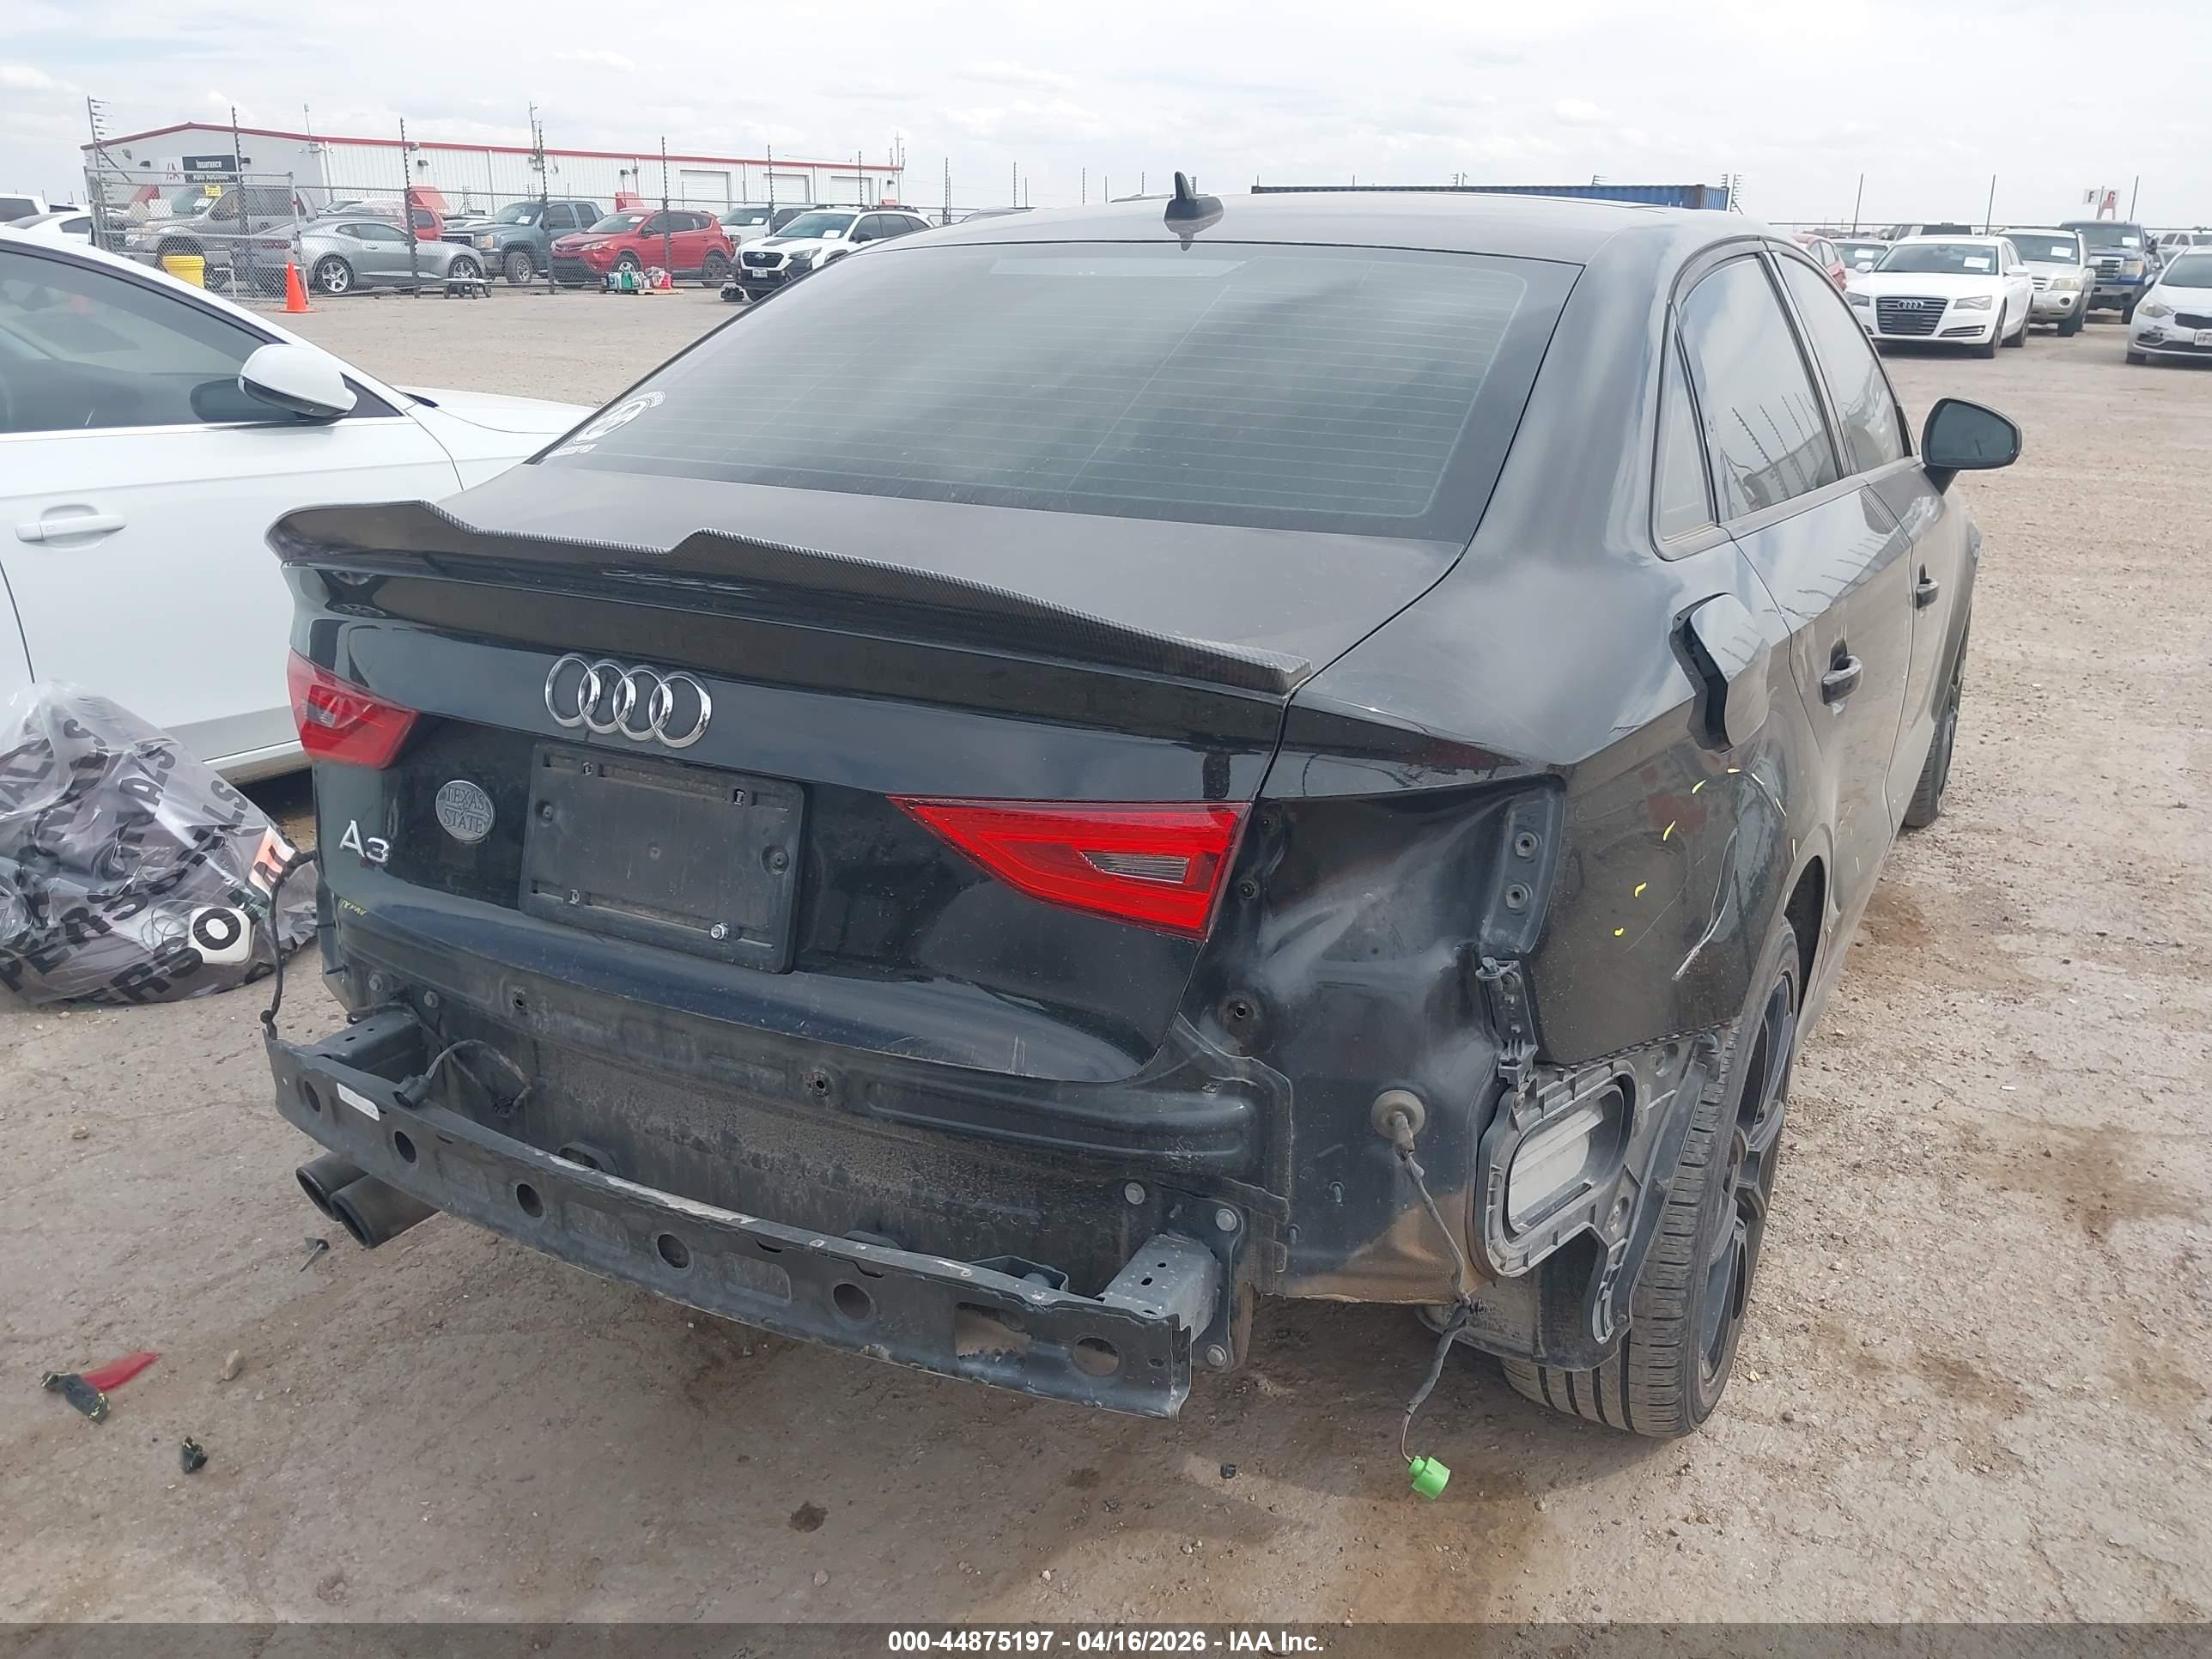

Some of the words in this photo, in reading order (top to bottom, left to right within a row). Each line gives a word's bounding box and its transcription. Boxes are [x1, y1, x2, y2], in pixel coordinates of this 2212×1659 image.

[196, 159, 222, 168] Insurance
[2088, 191, 2095, 203] F
[2107, 191, 2116, 203] G
[445, 786, 485, 811] TEXAS
[443, 809, 483, 835] STATE
[338, 819, 390, 864] A3
